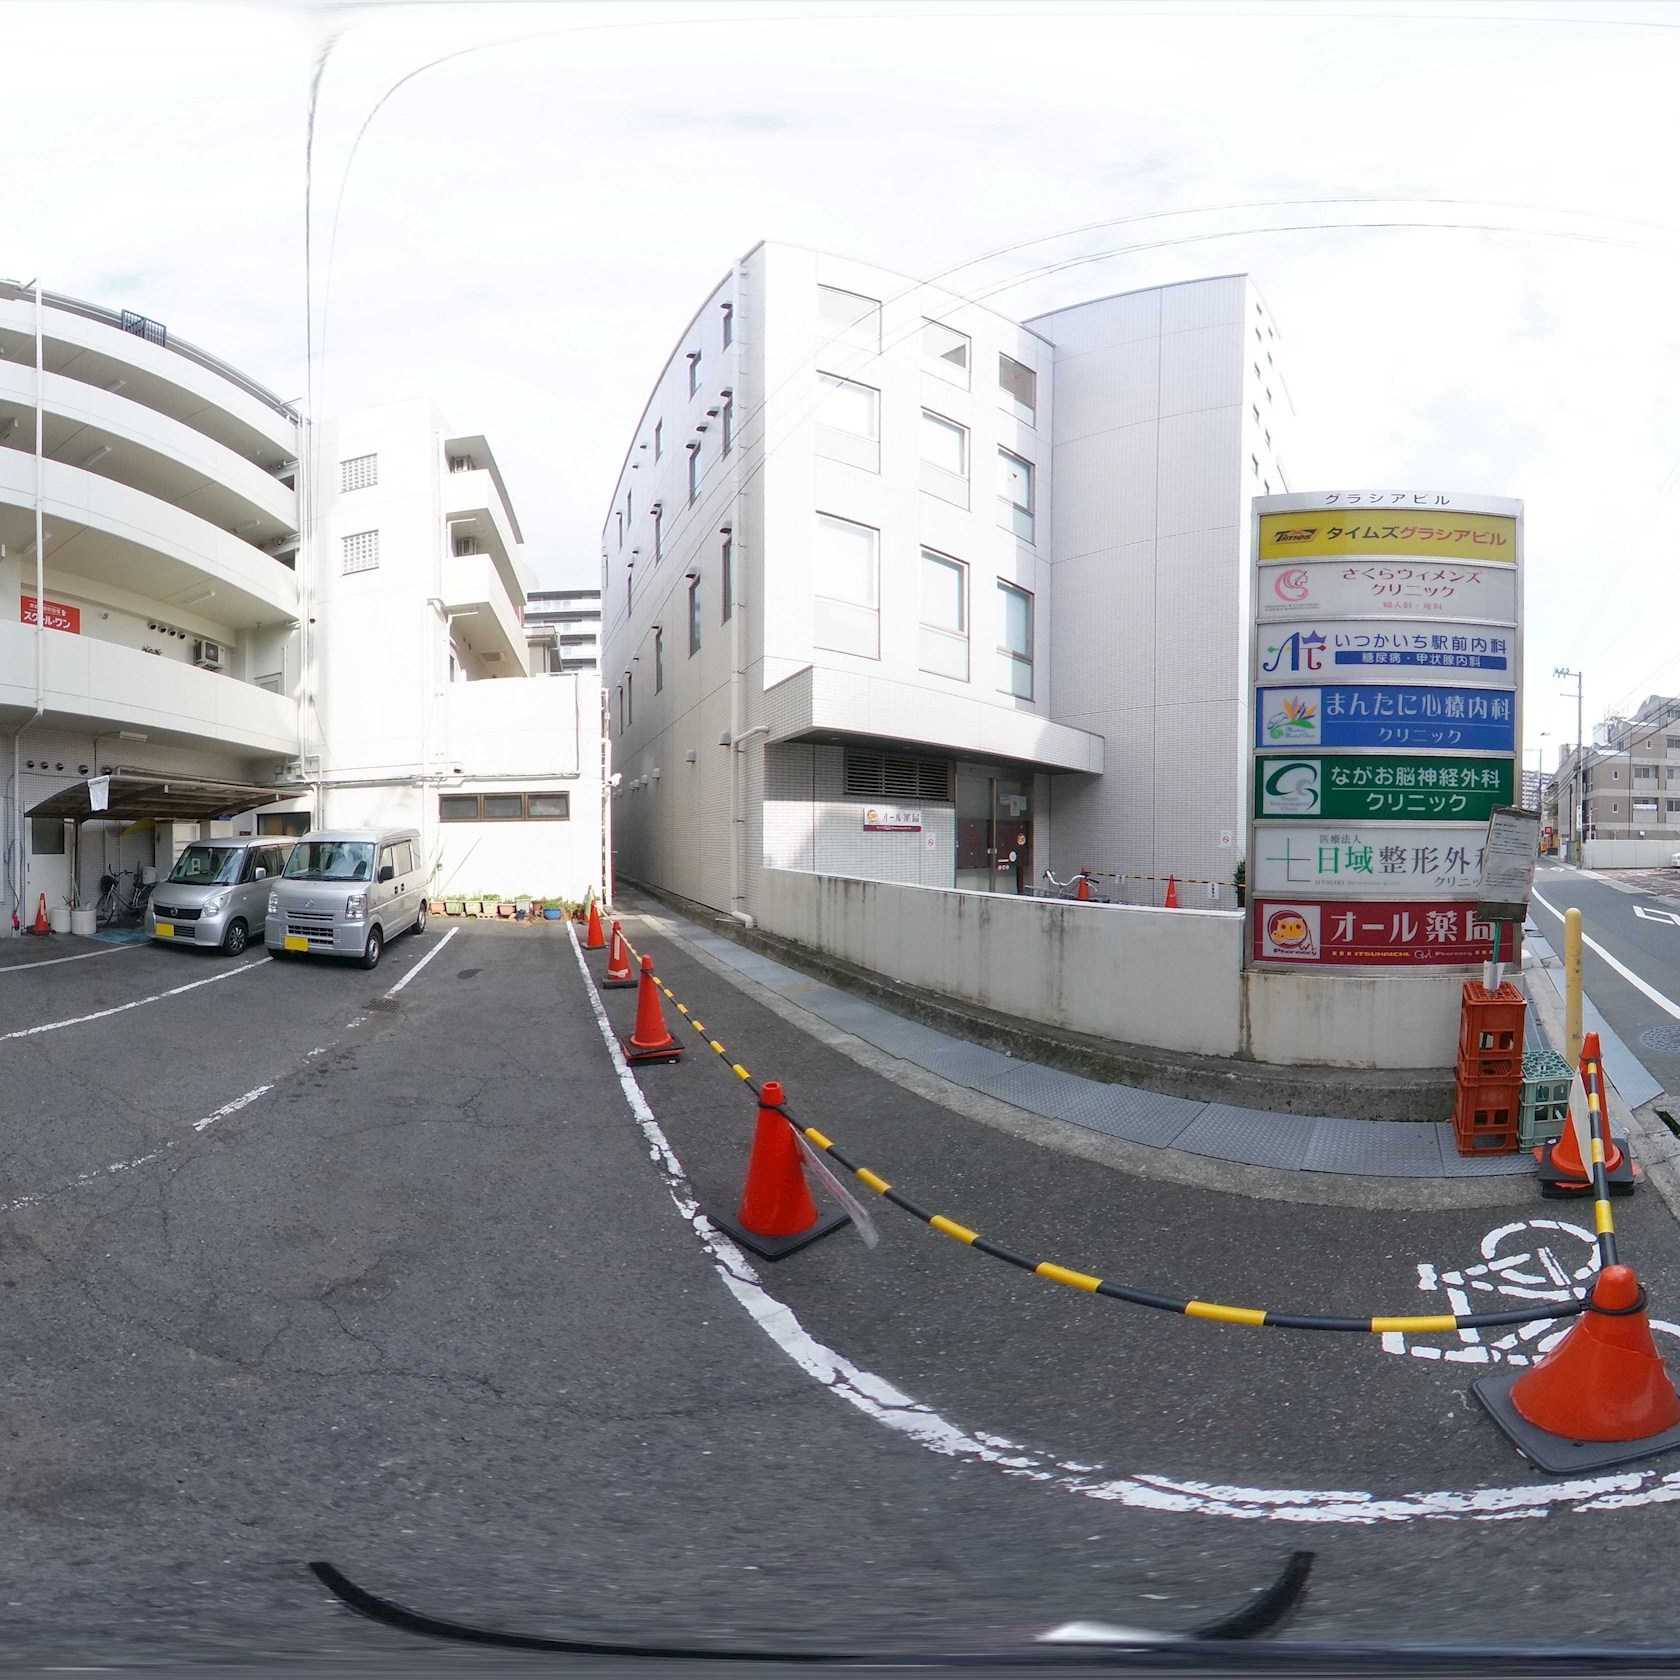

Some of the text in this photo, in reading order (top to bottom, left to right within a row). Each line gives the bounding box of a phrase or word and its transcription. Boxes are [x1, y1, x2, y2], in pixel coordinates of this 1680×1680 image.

[1325, 493, 1450, 505] グラシアビル
[1326, 526, 1507, 547] タイムズグラシアビル
[1342, 567, 1482, 584] さくらウィメンズ
[1371, 583, 1456, 599] クリニック
[23, 610, 71, 629] スクル・ワン
[1335, 633, 1507, 655] いつかいち駅前内科
[1361, 654, 1482, 668] 糖尿病・甲状腺内科
[1326, 693, 1511, 721] まんたに心療内科
[1378, 728, 1463, 745] クリニック
[1331, 766, 1501, 789] ながお脳神経外科
[1365, 793, 1467, 813] クリニック
[1319, 833, 1362, 845] 医療法人
[1433, 876, 1483, 889] クリニッ
